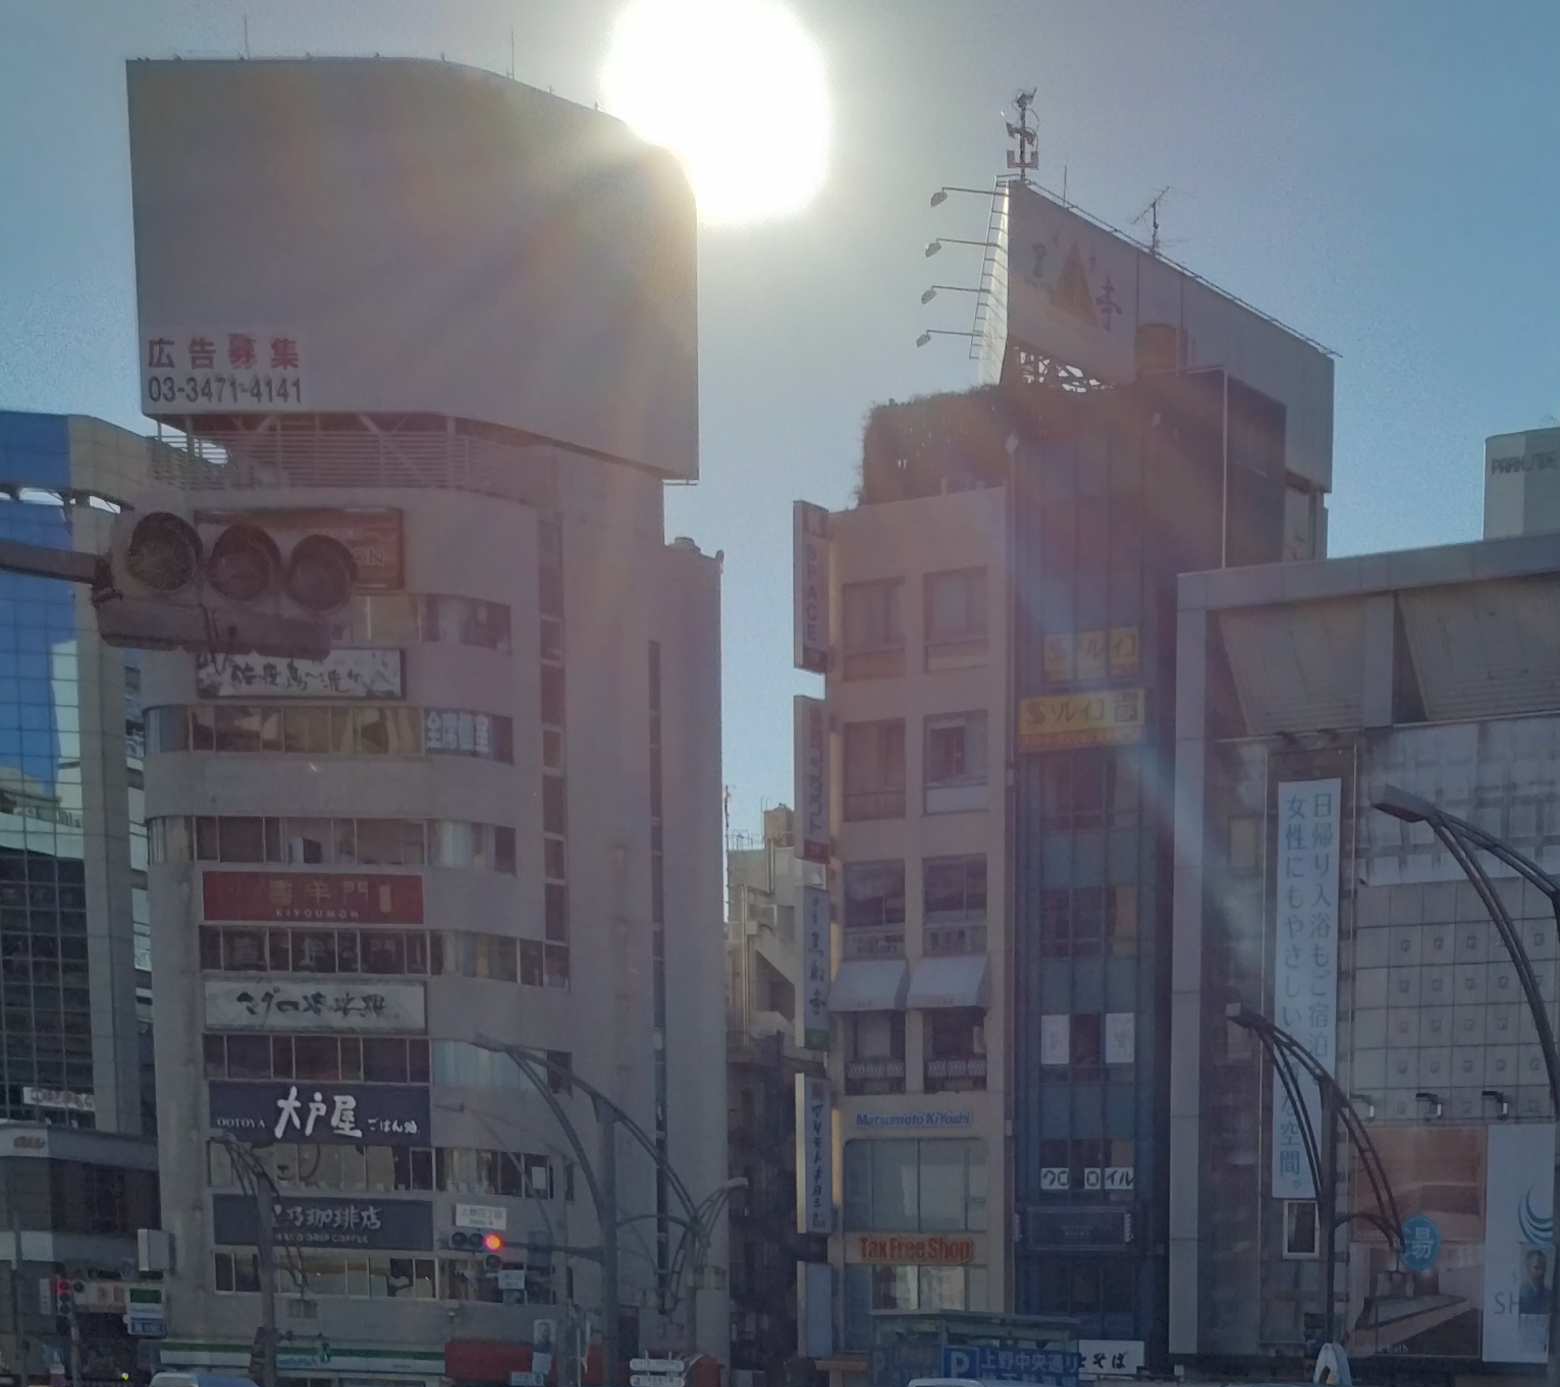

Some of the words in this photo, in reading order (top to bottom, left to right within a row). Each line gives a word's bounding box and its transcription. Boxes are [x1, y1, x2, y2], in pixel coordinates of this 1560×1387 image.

[148, 333, 299, 370] 広告募集
[148, 375, 301, 403] 03-3471-4141
[1308, 792, 1334, 1086] 日帰り入浴もご宿泊
[1279, 793, 1309, 1190] 女性にもやさしいな空間。
[217, 1118, 266, 1128] OOTOYA
[274, 1085, 363, 1139] 大戸屋
[856, 1113, 924, 1126] Matsumoto
[859, 1236, 888, 1259] Tax
[890, 1237, 926, 1259] Free
[928, 1237, 971, 1262] Shop
[951, 1351, 969, 1378] P
[981, 1350, 1078, 1373] 上野中央通り
